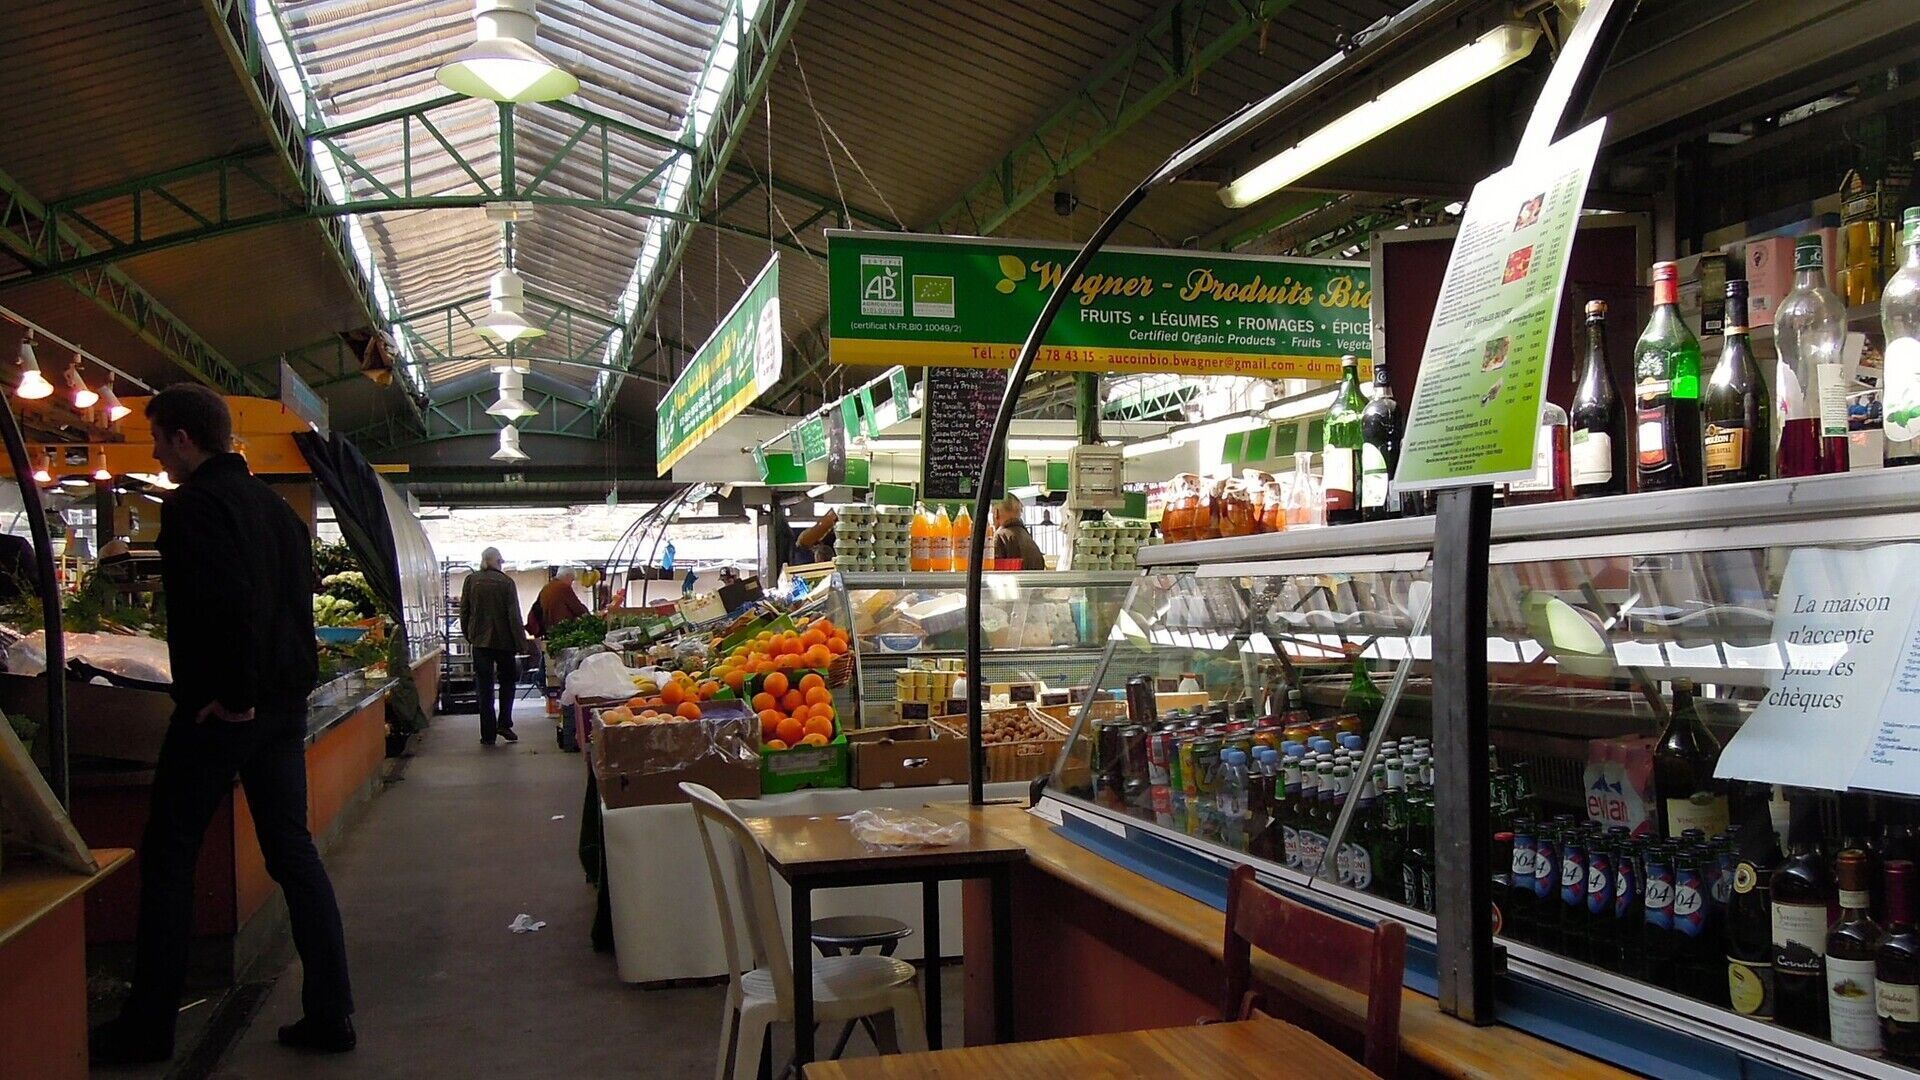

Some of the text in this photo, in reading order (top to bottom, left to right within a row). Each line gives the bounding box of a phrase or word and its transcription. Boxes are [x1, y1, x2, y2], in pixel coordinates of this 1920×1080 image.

[865, 275, 896, 299] AB
[1180, 268, 1313, 305] Produits
[850, 322, 961, 333] (certificat N.FR.BIO 10049/2)
[1080, 309, 1132, 324] FRUITS
[1152, 310, 1219, 328] LÉGUMES
[1238, 317, 1314, 332] FROMAGES
[1129, 329, 1178, 342] Certified
[1182, 332, 1224, 346] Organic
[1228, 334, 1275, 346] Products
[1292, 337, 1321, 348] Fruits
[972, 347, 996, 359] Tél.
[1046, 350, 1060, 361] 78
[1065, 351, 1078, 362] 43
[1083, 351, 1095, 362] 15
[1108, 353, 1295, 371] aucoinbio.bwagner@gmail.com
[1307, 360, 1321, 371] du
[1793, 594, 1890, 614] La maison
[1788, 625, 1874, 645] n'accepte
[1828, 656, 1855, 677] les
[1768, 687, 1844, 713] chèques
